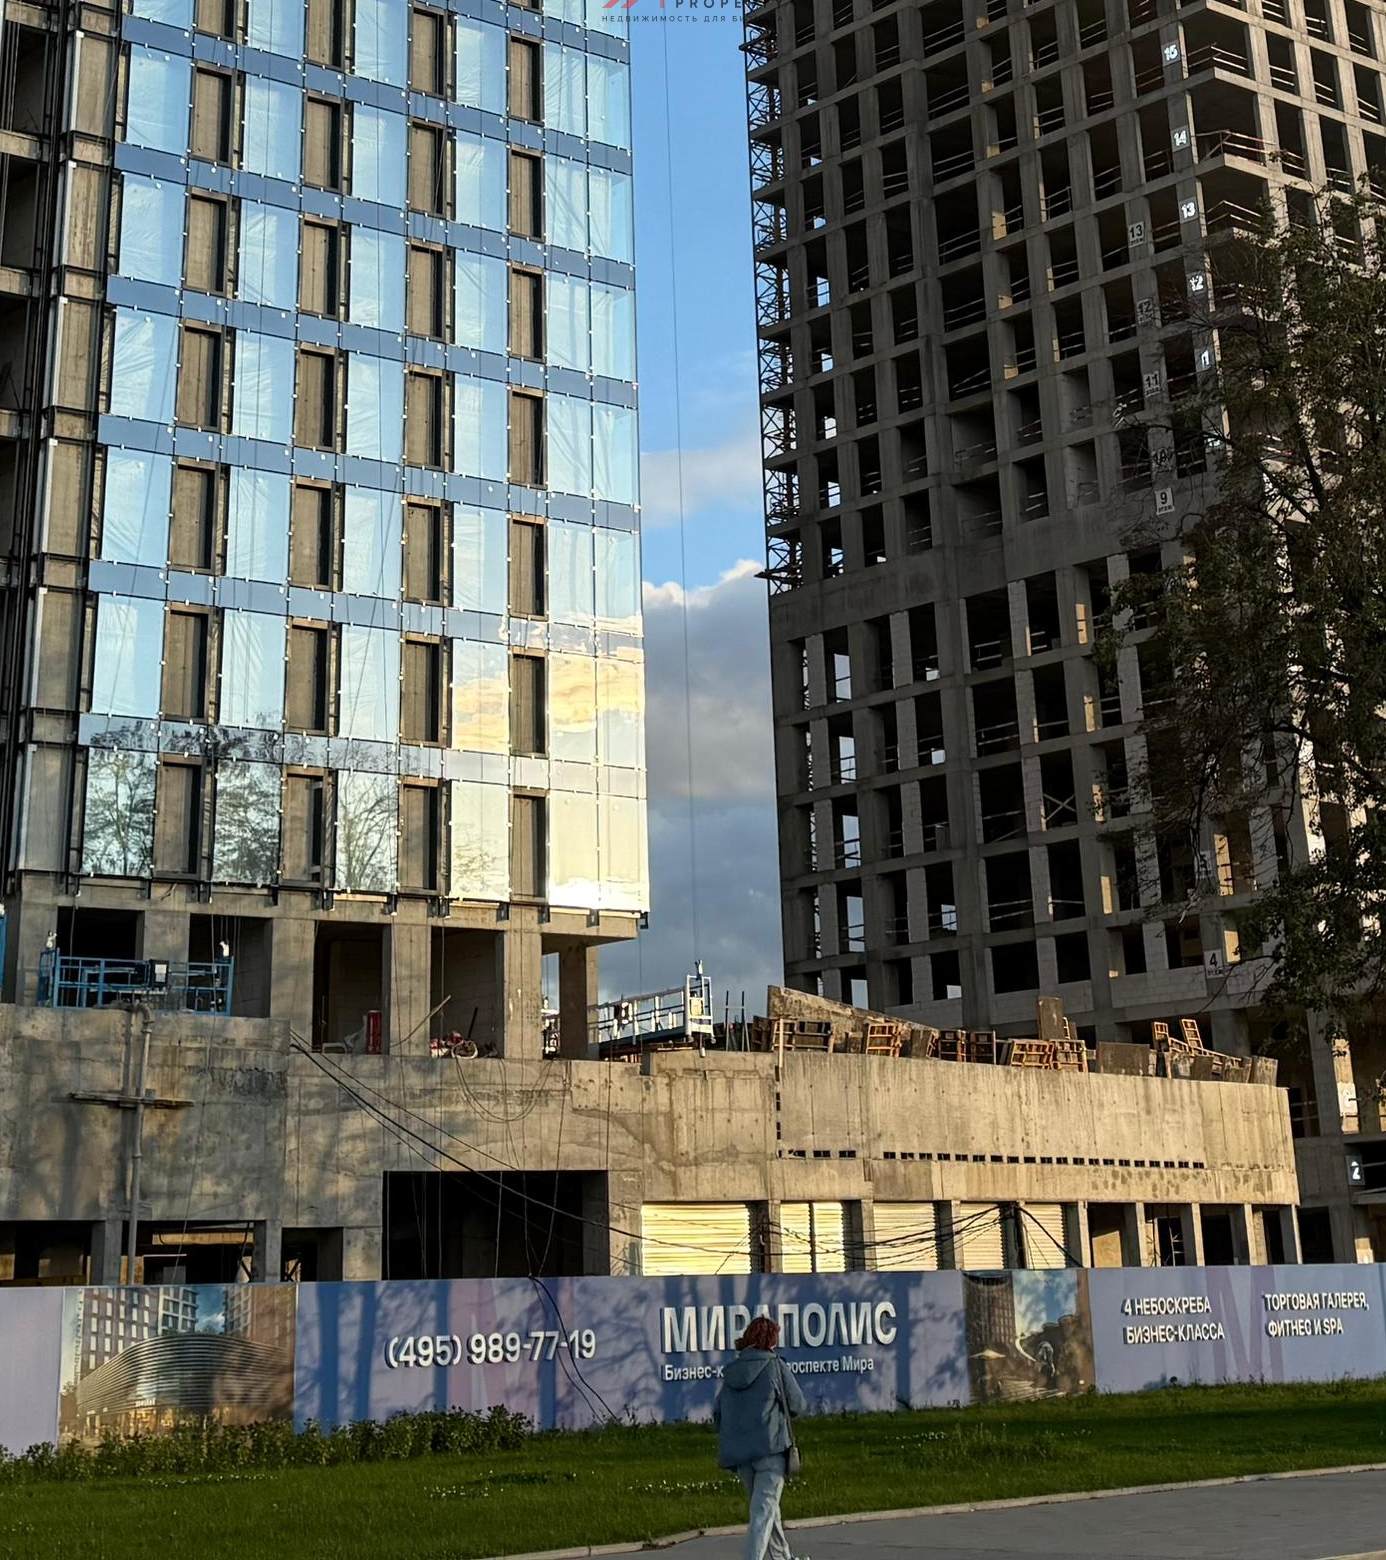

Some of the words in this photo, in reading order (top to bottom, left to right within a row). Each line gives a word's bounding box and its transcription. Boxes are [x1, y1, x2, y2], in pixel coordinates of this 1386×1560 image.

[1173, 130, 1187, 146] 14
[1181, 202, 1196, 218] 13
[1130, 224, 1143, 239] 13
[1160, 491, 1168, 505] 9
[1210, 952, 1218, 967] 4
[1124, 1298, 1132, 1315] 4
[1135, 1296, 1212, 1315] НЕБОСКРЕБА
[1265, 1293, 1320, 1311] ТОРГОВАЯ
[1322, 1292, 1370, 1310] ГАЛЕРЕЯ,
[1126, 1322, 1225, 1344] БИЗНЕС-КЛАССА
[1268, 1319, 1312, 1337] ФИТНЕС
[1314, 1318, 1322, 1336] И
[1324, 1317, 1344, 1335] SPA
[388, 1334, 462, 1368] (495)
[470, 1328, 596, 1365] 989-77-19
[665, 1363, 724, 1382] Бизнес-к
[786, 1357, 839, 1375] оспекте
[843, 1355, 874, 1375] Мира
